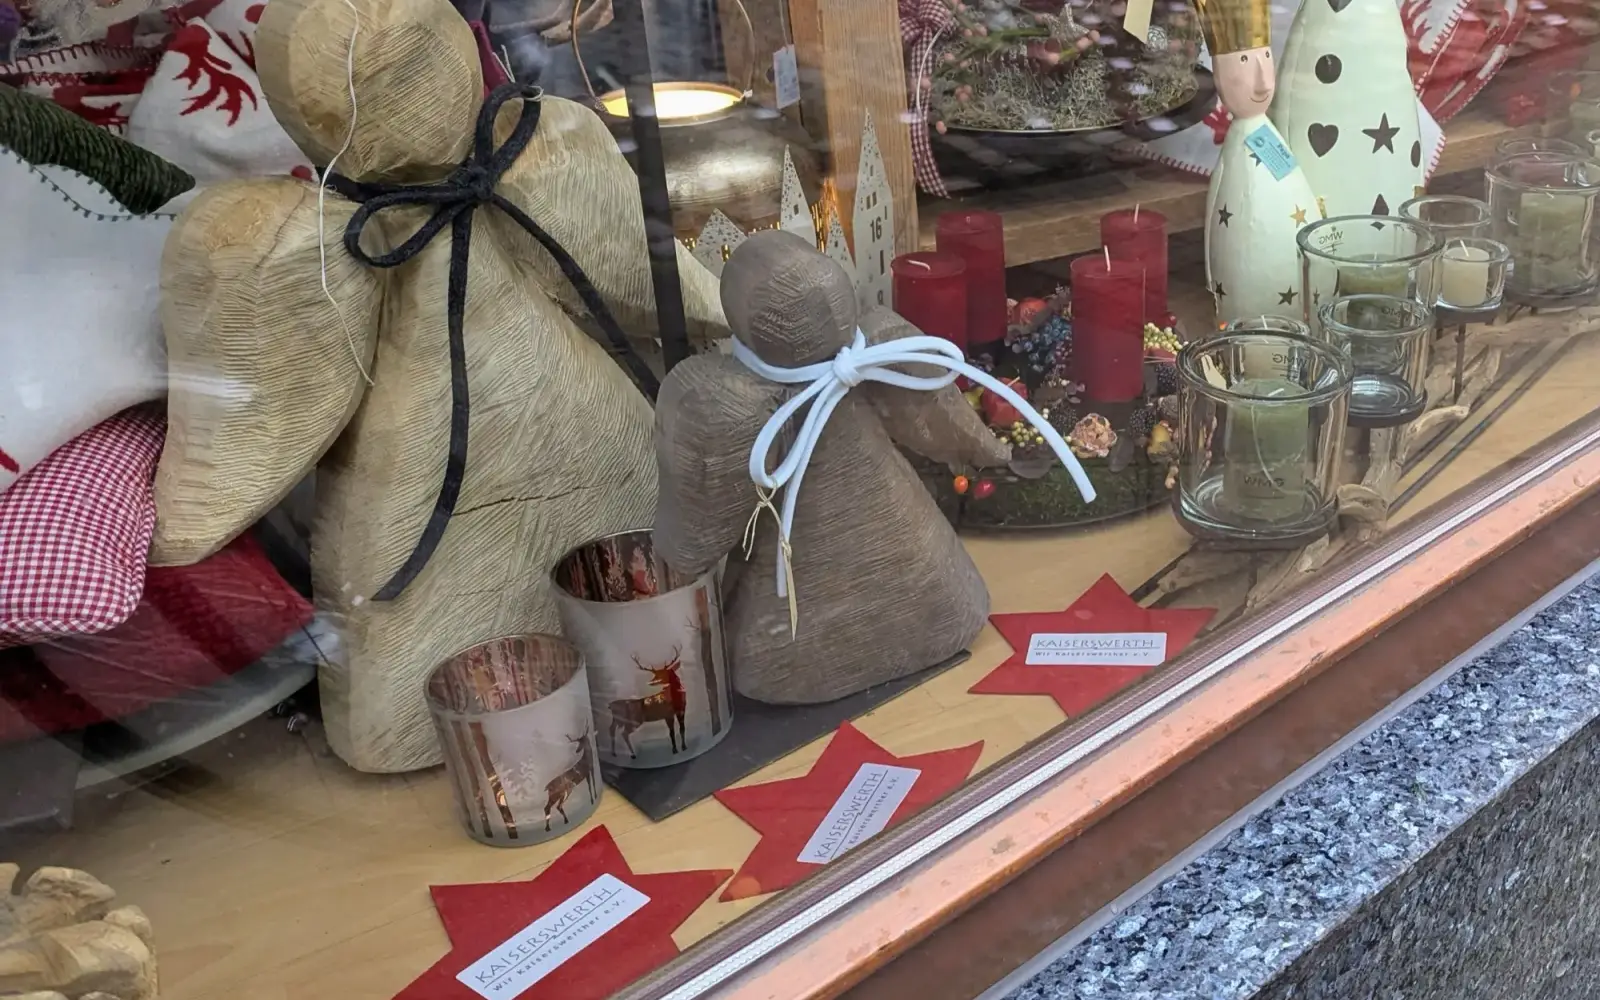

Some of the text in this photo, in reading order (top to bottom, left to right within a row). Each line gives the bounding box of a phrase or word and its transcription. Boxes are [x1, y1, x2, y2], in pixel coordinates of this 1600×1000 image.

[869, 216, 882, 243] 16
[1036, 639, 1154, 648] KAISERSWERTH
[814, 772, 882, 859] KAISERSWERTH
[474, 887, 612, 983] KAISERSWERTH
